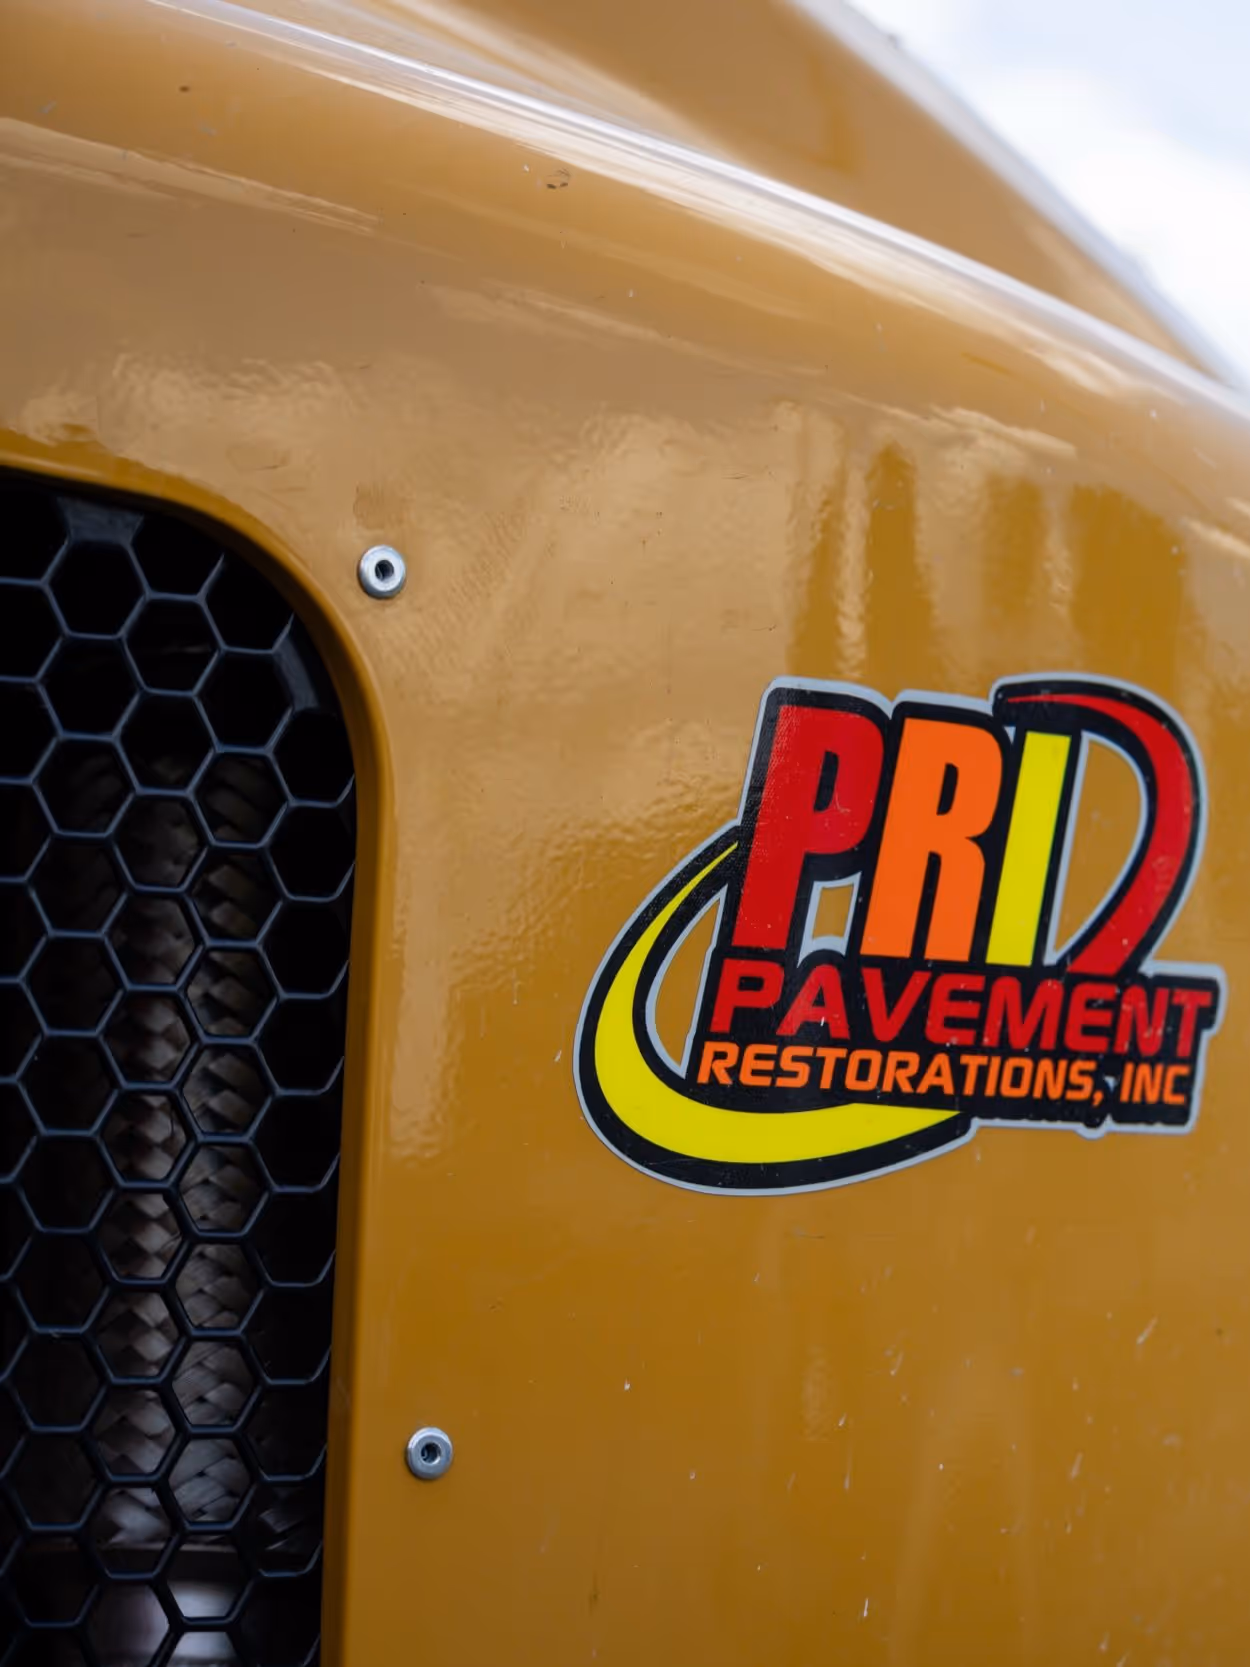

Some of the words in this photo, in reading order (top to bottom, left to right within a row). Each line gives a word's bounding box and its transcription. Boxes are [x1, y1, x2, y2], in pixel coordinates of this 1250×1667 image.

[731, 704, 1071, 967] PRI
[709, 958, 1212, 1058] PAVEMENT
[697, 1041, 1105, 1107] RESTORATIONS,
[1119, 1063, 1191, 1106] INC
